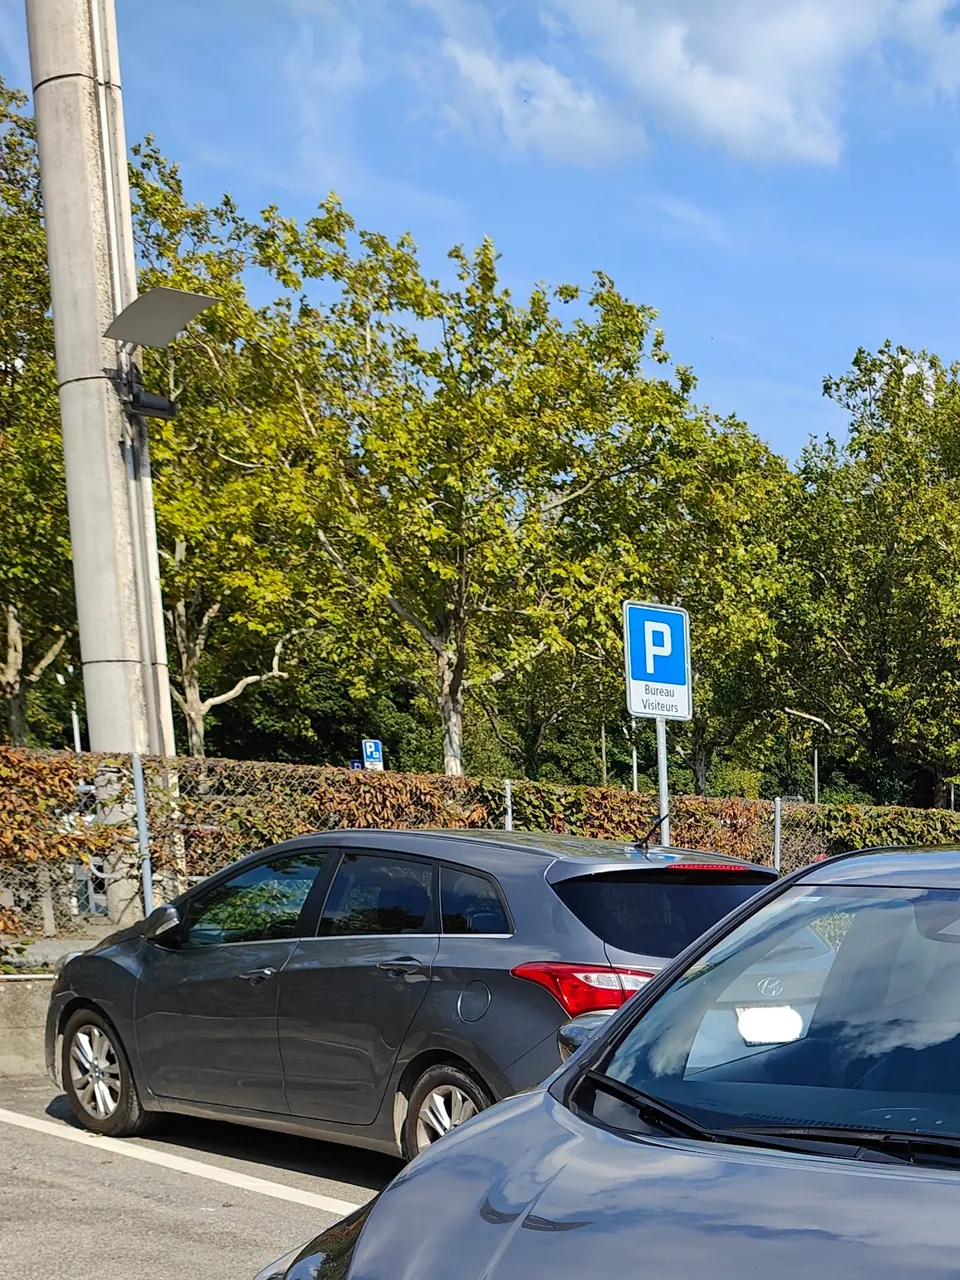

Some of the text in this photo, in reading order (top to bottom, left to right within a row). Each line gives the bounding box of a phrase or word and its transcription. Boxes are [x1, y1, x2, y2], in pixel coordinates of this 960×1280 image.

[644, 620, 672, 675] P
[644, 684, 675, 698] Bureau
[641, 699, 679, 713] Visiteurs
